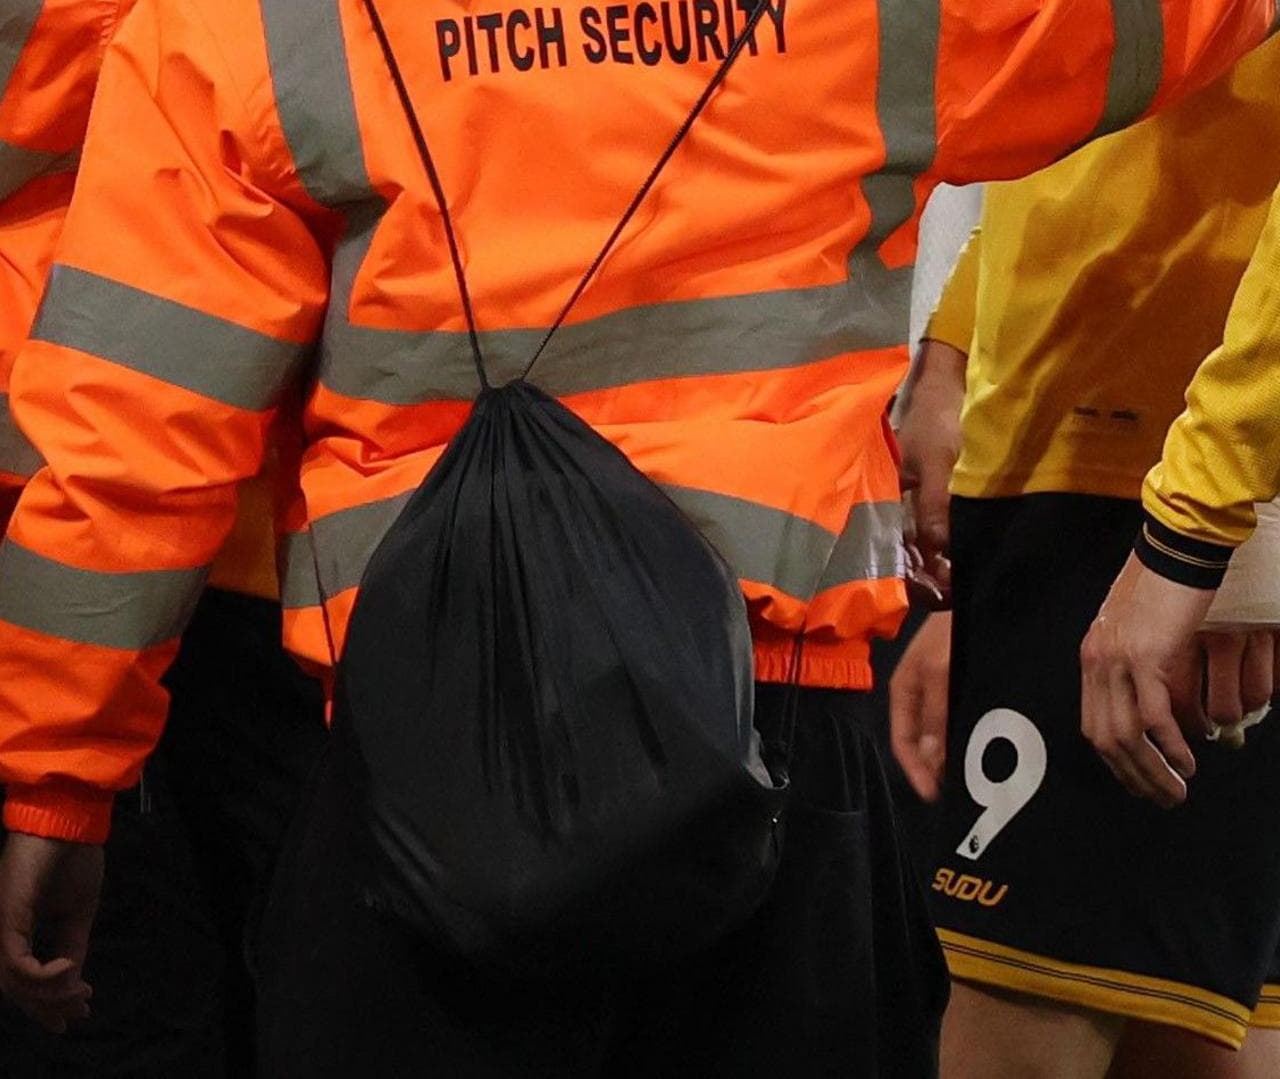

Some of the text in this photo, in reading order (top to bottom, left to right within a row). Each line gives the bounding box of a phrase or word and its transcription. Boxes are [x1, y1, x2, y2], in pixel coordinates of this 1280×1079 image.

[435, 6, 567, 82] PITCH
[955, 707, 1048, 861] 9
[931, 868, 1009, 907] SUDU
